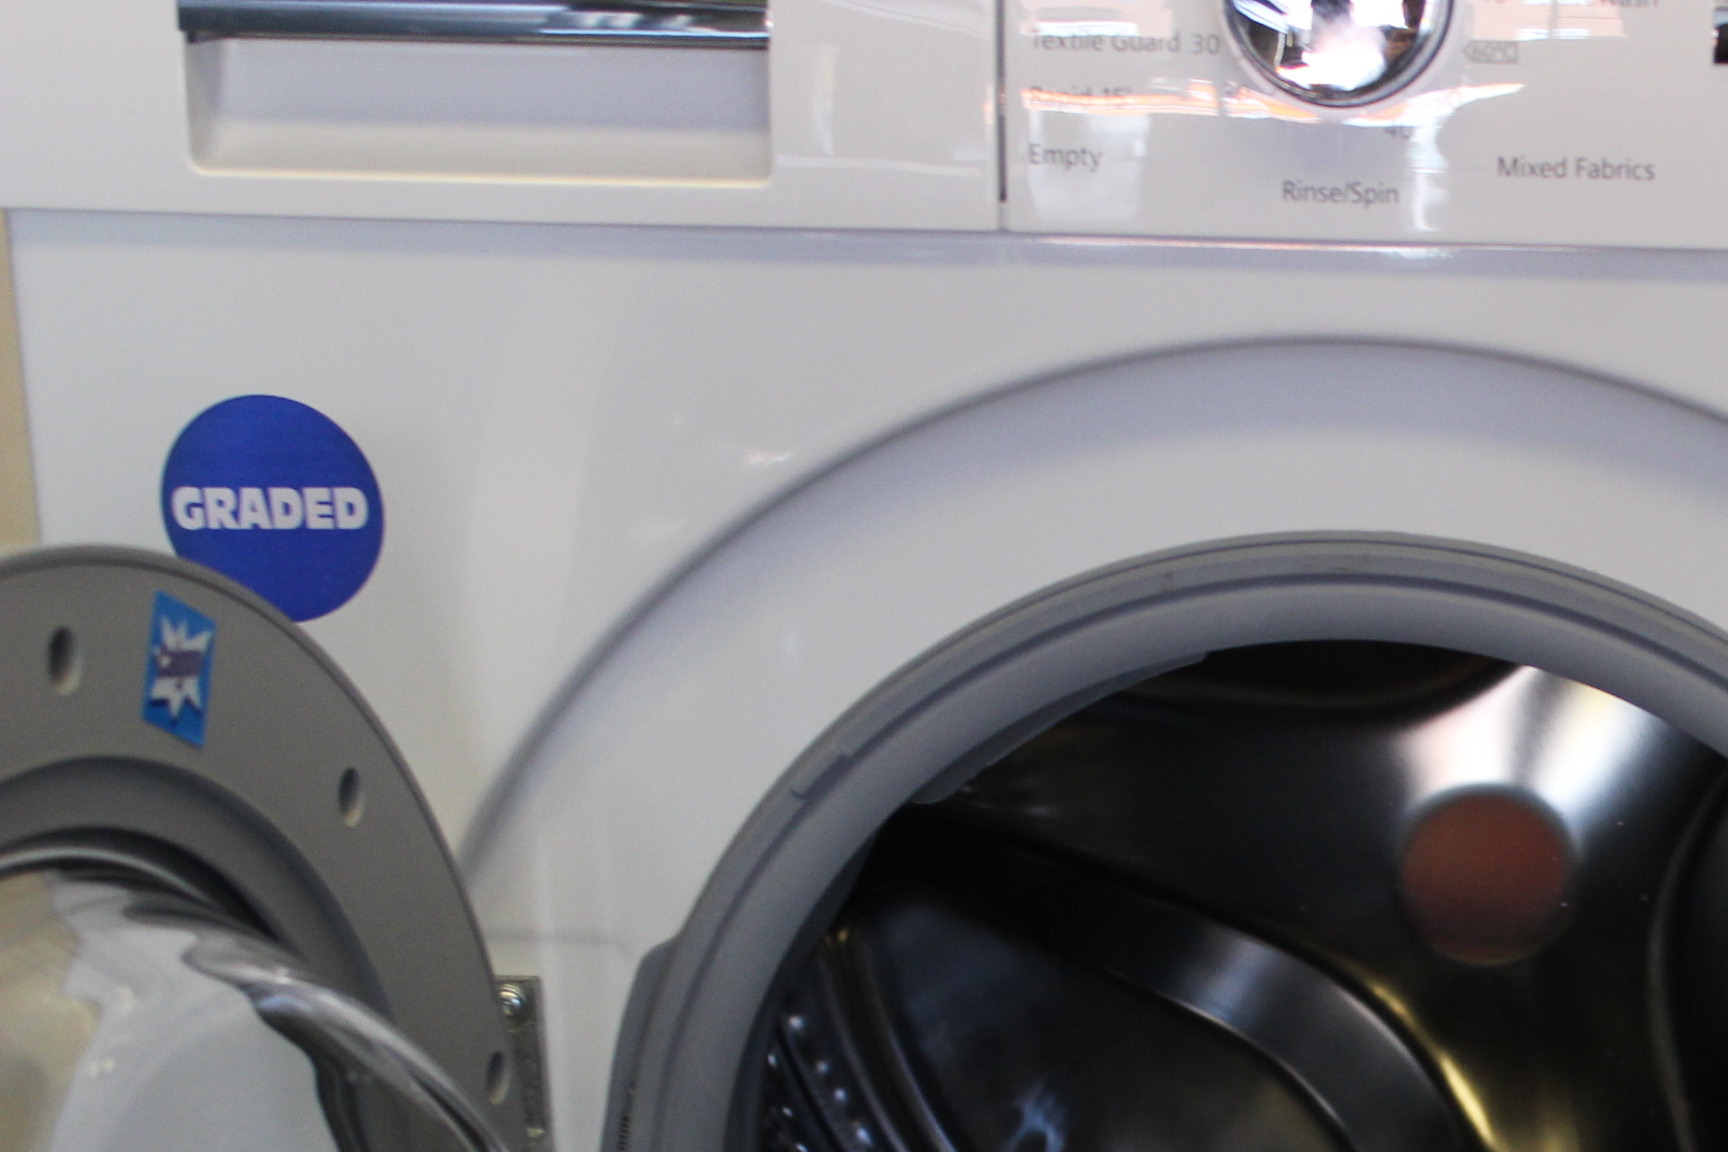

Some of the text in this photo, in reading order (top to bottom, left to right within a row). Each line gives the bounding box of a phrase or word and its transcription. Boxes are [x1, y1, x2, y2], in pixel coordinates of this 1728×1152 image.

[1190, 33, 1220, 55] 30
[1029, 144, 1103, 172] Empty
[1497, 156, 1655, 182] Mixed Fabrics
[1282, 179, 1400, 207] Rinse/Spin
[171, 486, 369, 530] GRADED
